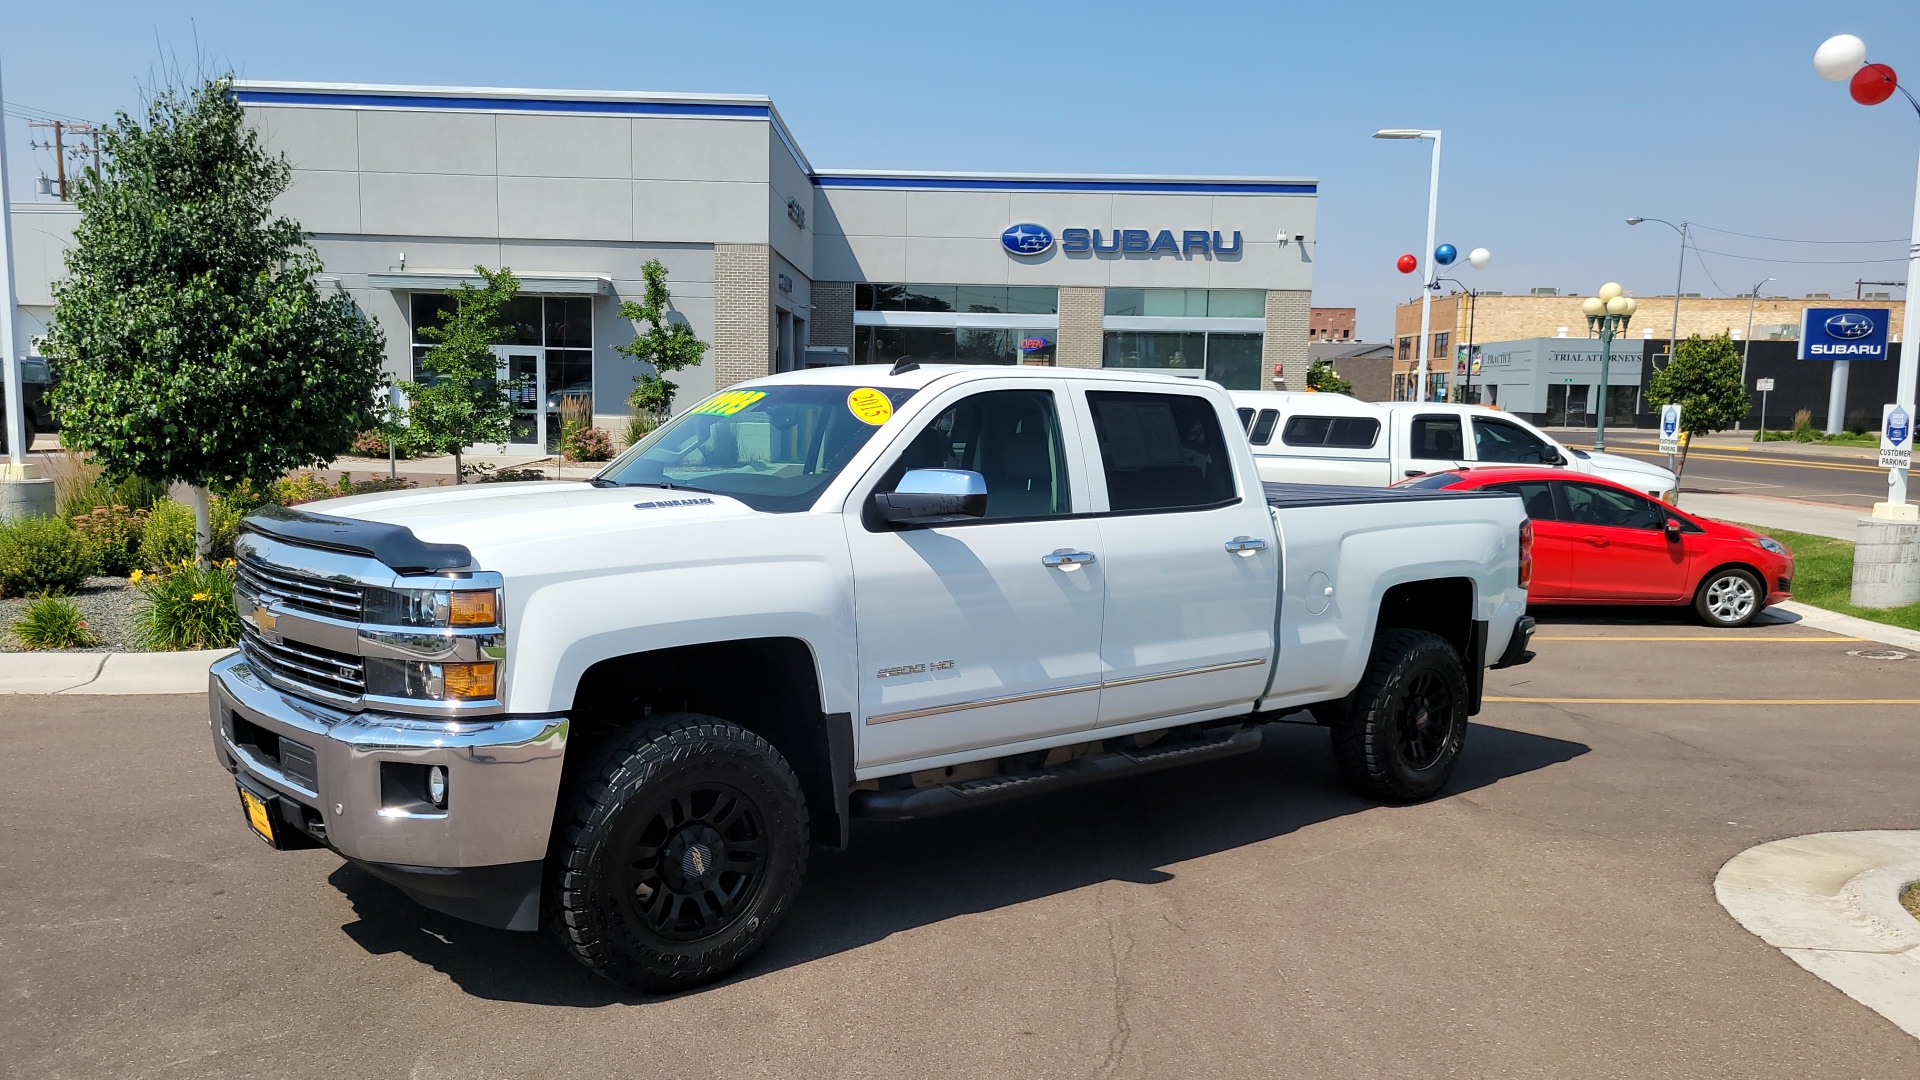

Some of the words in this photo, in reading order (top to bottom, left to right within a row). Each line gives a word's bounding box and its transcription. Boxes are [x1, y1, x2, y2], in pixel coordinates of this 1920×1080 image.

[1062, 228, 1241, 254] SUBARU
[1020, 339, 1044, 349] OPEN
[1810, 344, 1881, 355] SUBARU
[1488, 353, 1512, 364] PRACTICE
[1554, 353, 1583, 362] TRIAL
[1586, 354, 1642, 362] ATTRNEYS
[852, 393, 889, 418] 2015
[1880, 449, 1912, 458] CUSTOMER
[1881, 458, 1908, 467] PARKING
[655, 498, 715, 509] DURAMAX
[877, 664, 926, 678] 2500
[929, 660, 955, 671] HD
